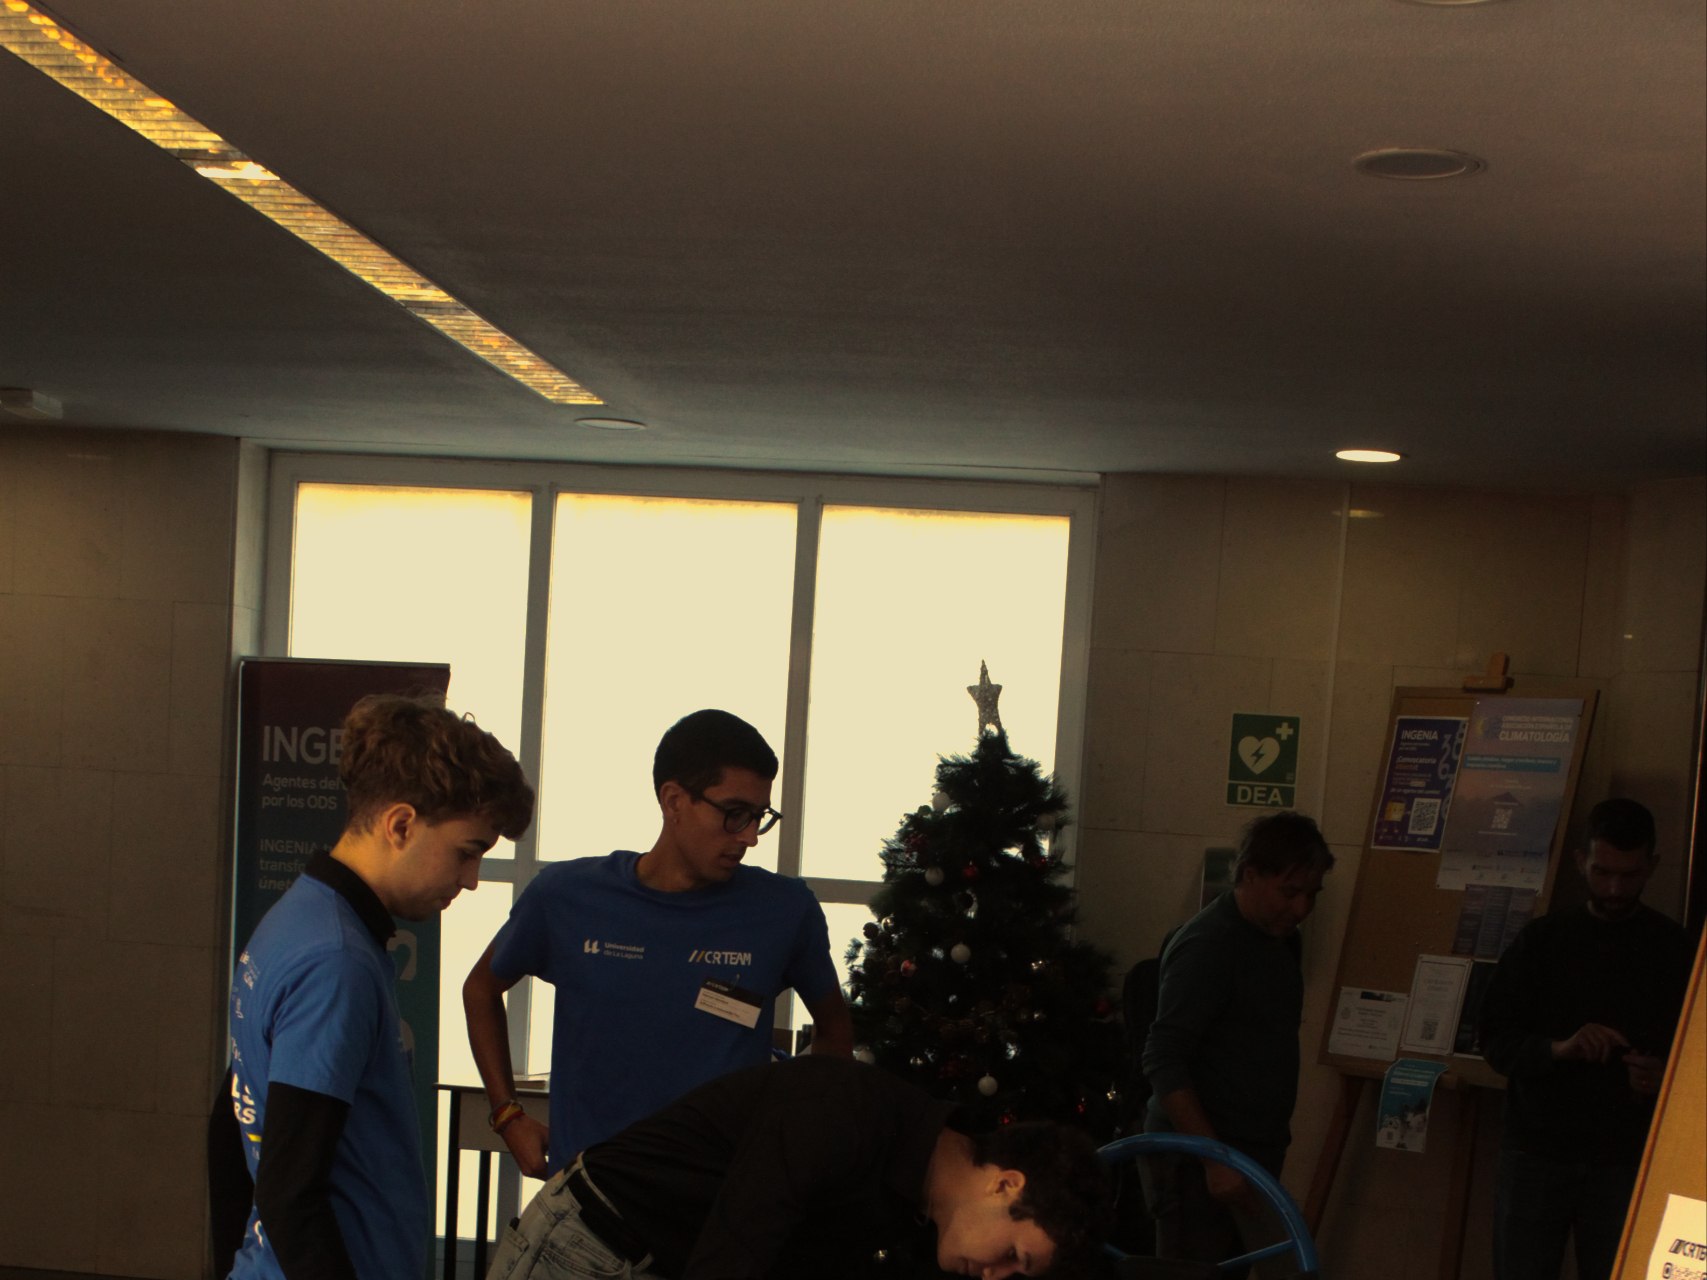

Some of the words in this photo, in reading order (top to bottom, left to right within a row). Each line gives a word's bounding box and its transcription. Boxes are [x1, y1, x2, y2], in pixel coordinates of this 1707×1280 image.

[1401, 730, 1439, 740] INGENIA
[262, 725, 346, 765] INGE
[262, 773, 317, 792] Agentes
[261, 795, 284, 808] por
[286, 794, 304, 808] los
[306, 795, 338, 810] ODS
[1236, 785, 1284, 805] DEA
[259, 838, 319, 856] INGENIA
[259, 859, 307, 873] transfo
[604, 942, 645, 953] Universidad
